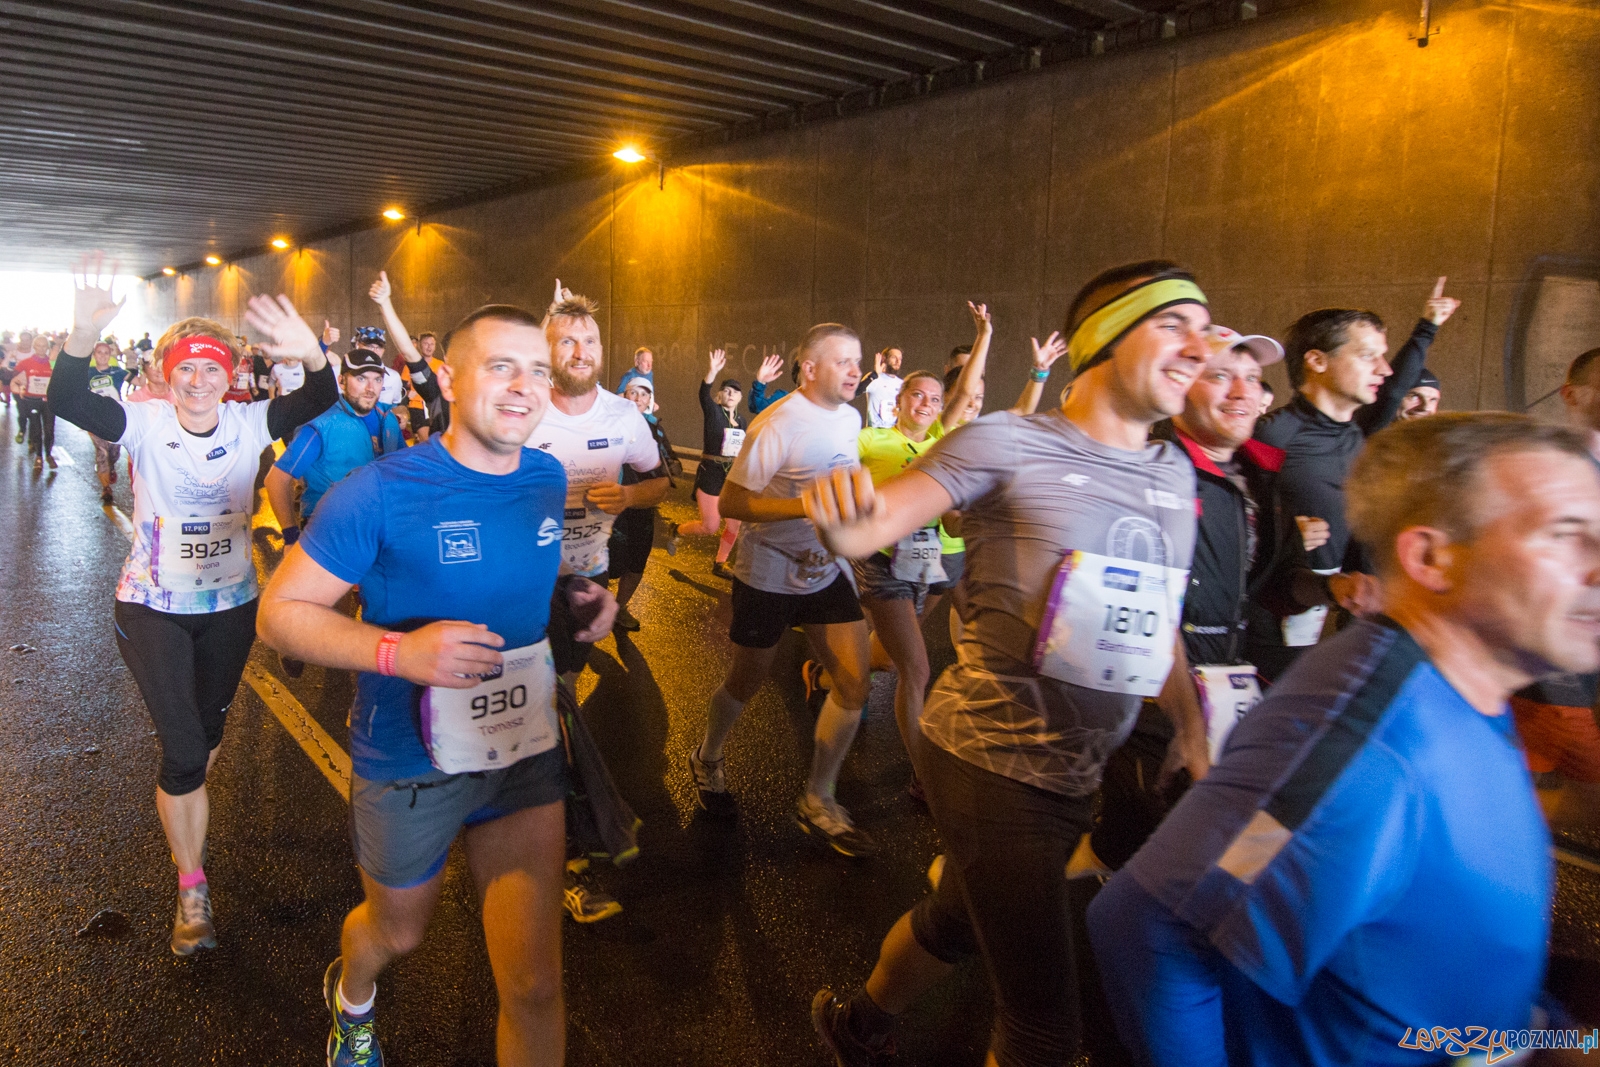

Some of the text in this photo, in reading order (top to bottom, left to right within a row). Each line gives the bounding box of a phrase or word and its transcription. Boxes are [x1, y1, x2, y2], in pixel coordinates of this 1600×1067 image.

[562, 522, 603, 541] 2525
[180, 538, 232, 559] 3923
[196, 561, 220, 570] Iwona
[1103, 603, 1158, 637] 1810
[471, 684, 528, 720] 930
[479, 717, 525, 736] Tomasz
